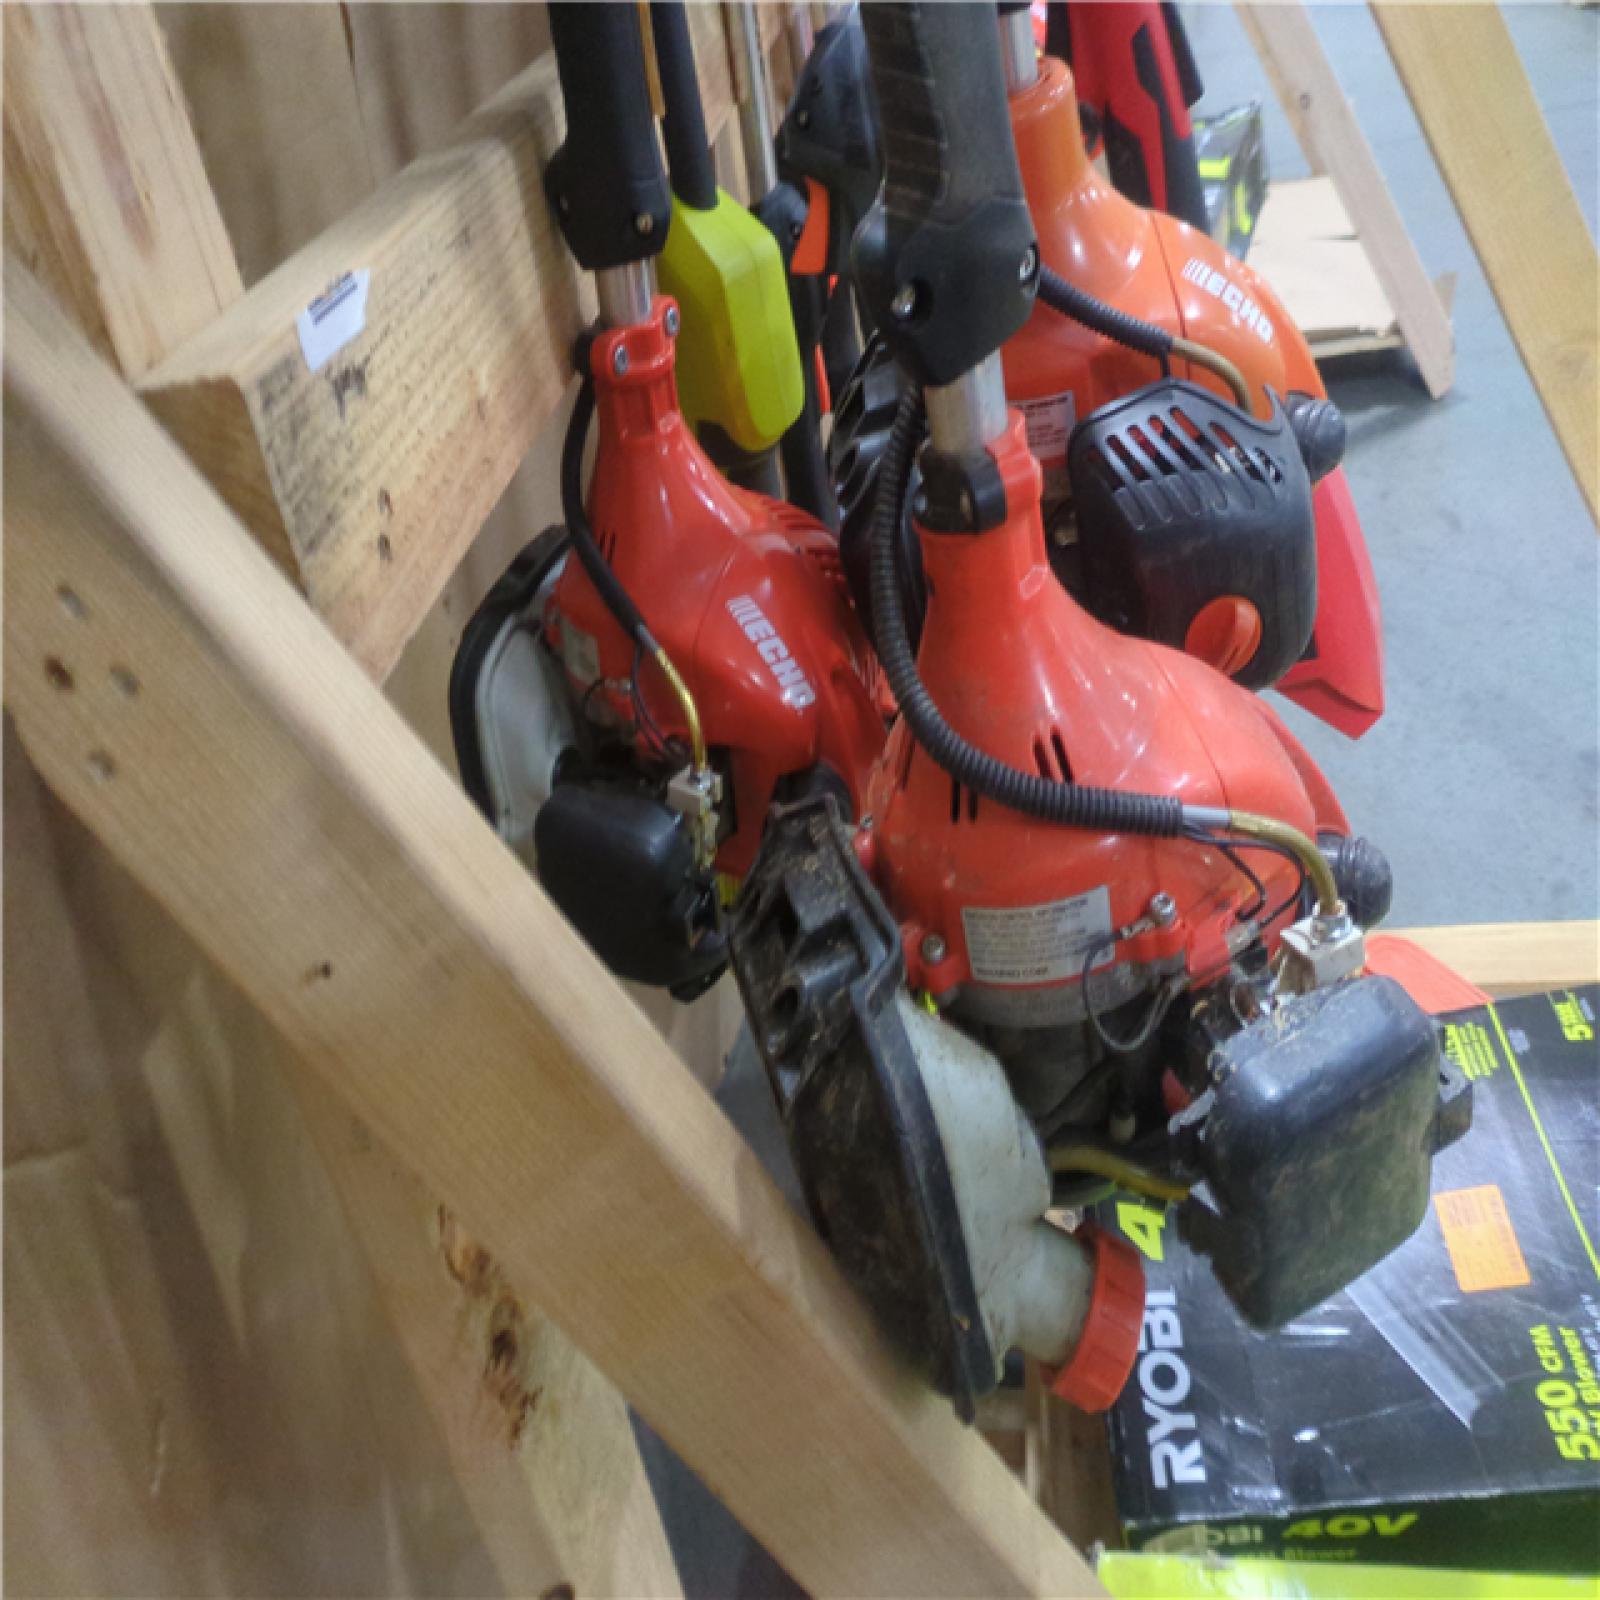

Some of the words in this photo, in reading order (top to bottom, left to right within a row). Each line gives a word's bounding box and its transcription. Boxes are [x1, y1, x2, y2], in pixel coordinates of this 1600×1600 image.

[1204, 271, 1274, 344] ECHO
[744, 619, 816, 709] ECHO
[1116, 1201, 1166, 1262] 4
[1529, 1324, 1564, 1373] CFM
[1138, 1285, 1206, 1489] RYOBI
[1535, 1379, 1600, 1461] 550
[1282, 1512, 1418, 1538] 40V
